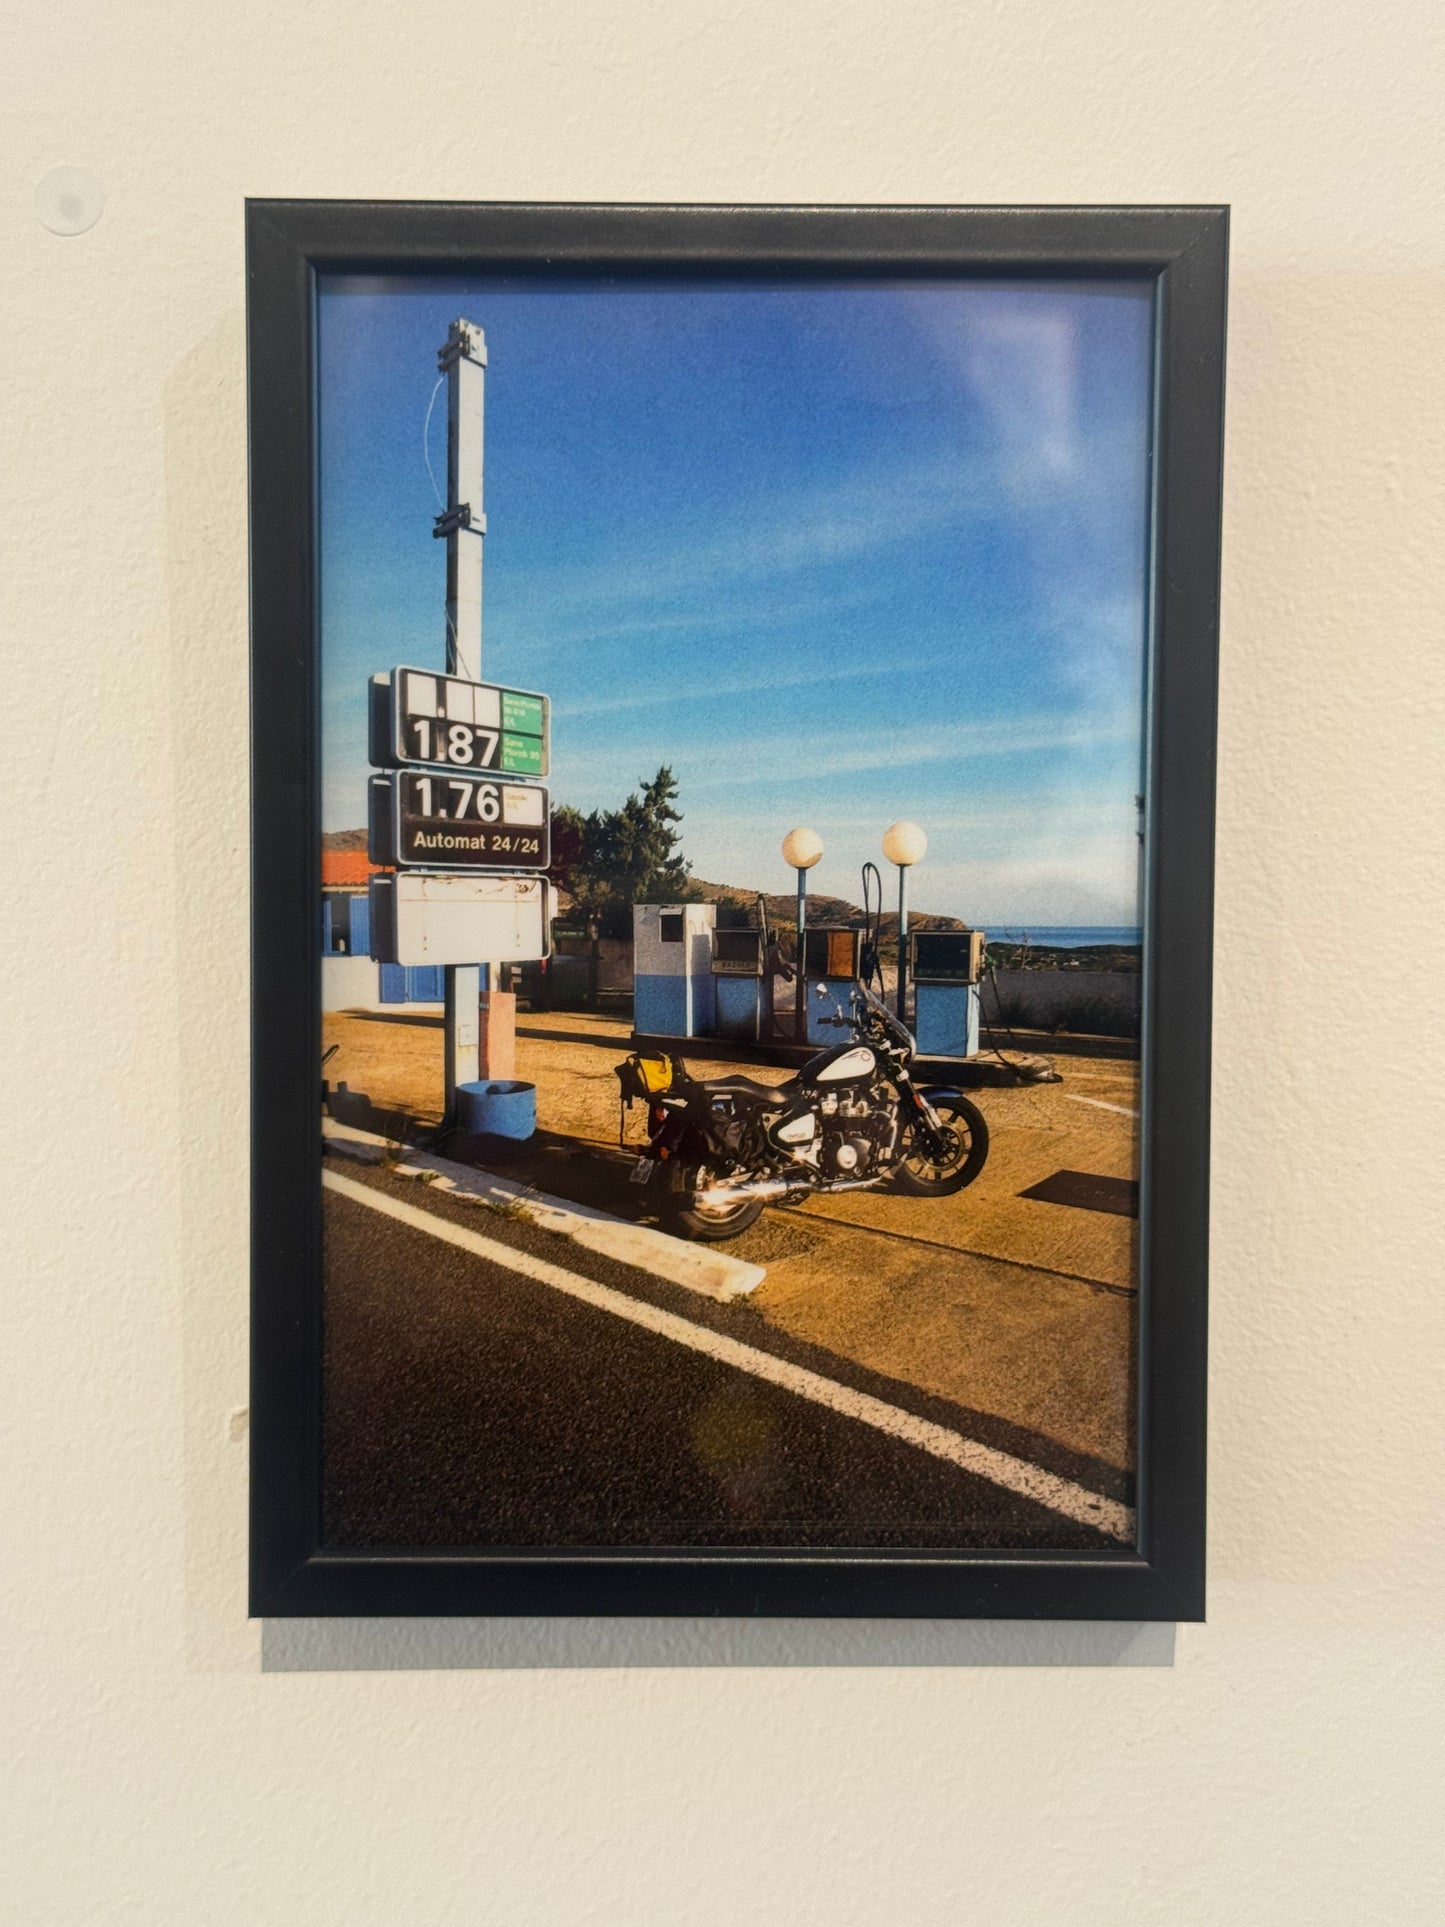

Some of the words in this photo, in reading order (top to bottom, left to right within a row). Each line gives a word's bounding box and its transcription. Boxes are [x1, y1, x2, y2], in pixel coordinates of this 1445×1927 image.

[414, 720, 499, 767] 1.87
[416, 778, 499, 822] 1.76
[413, 831, 486, 850] Automat
[492, 836, 539, 854] 24/24
